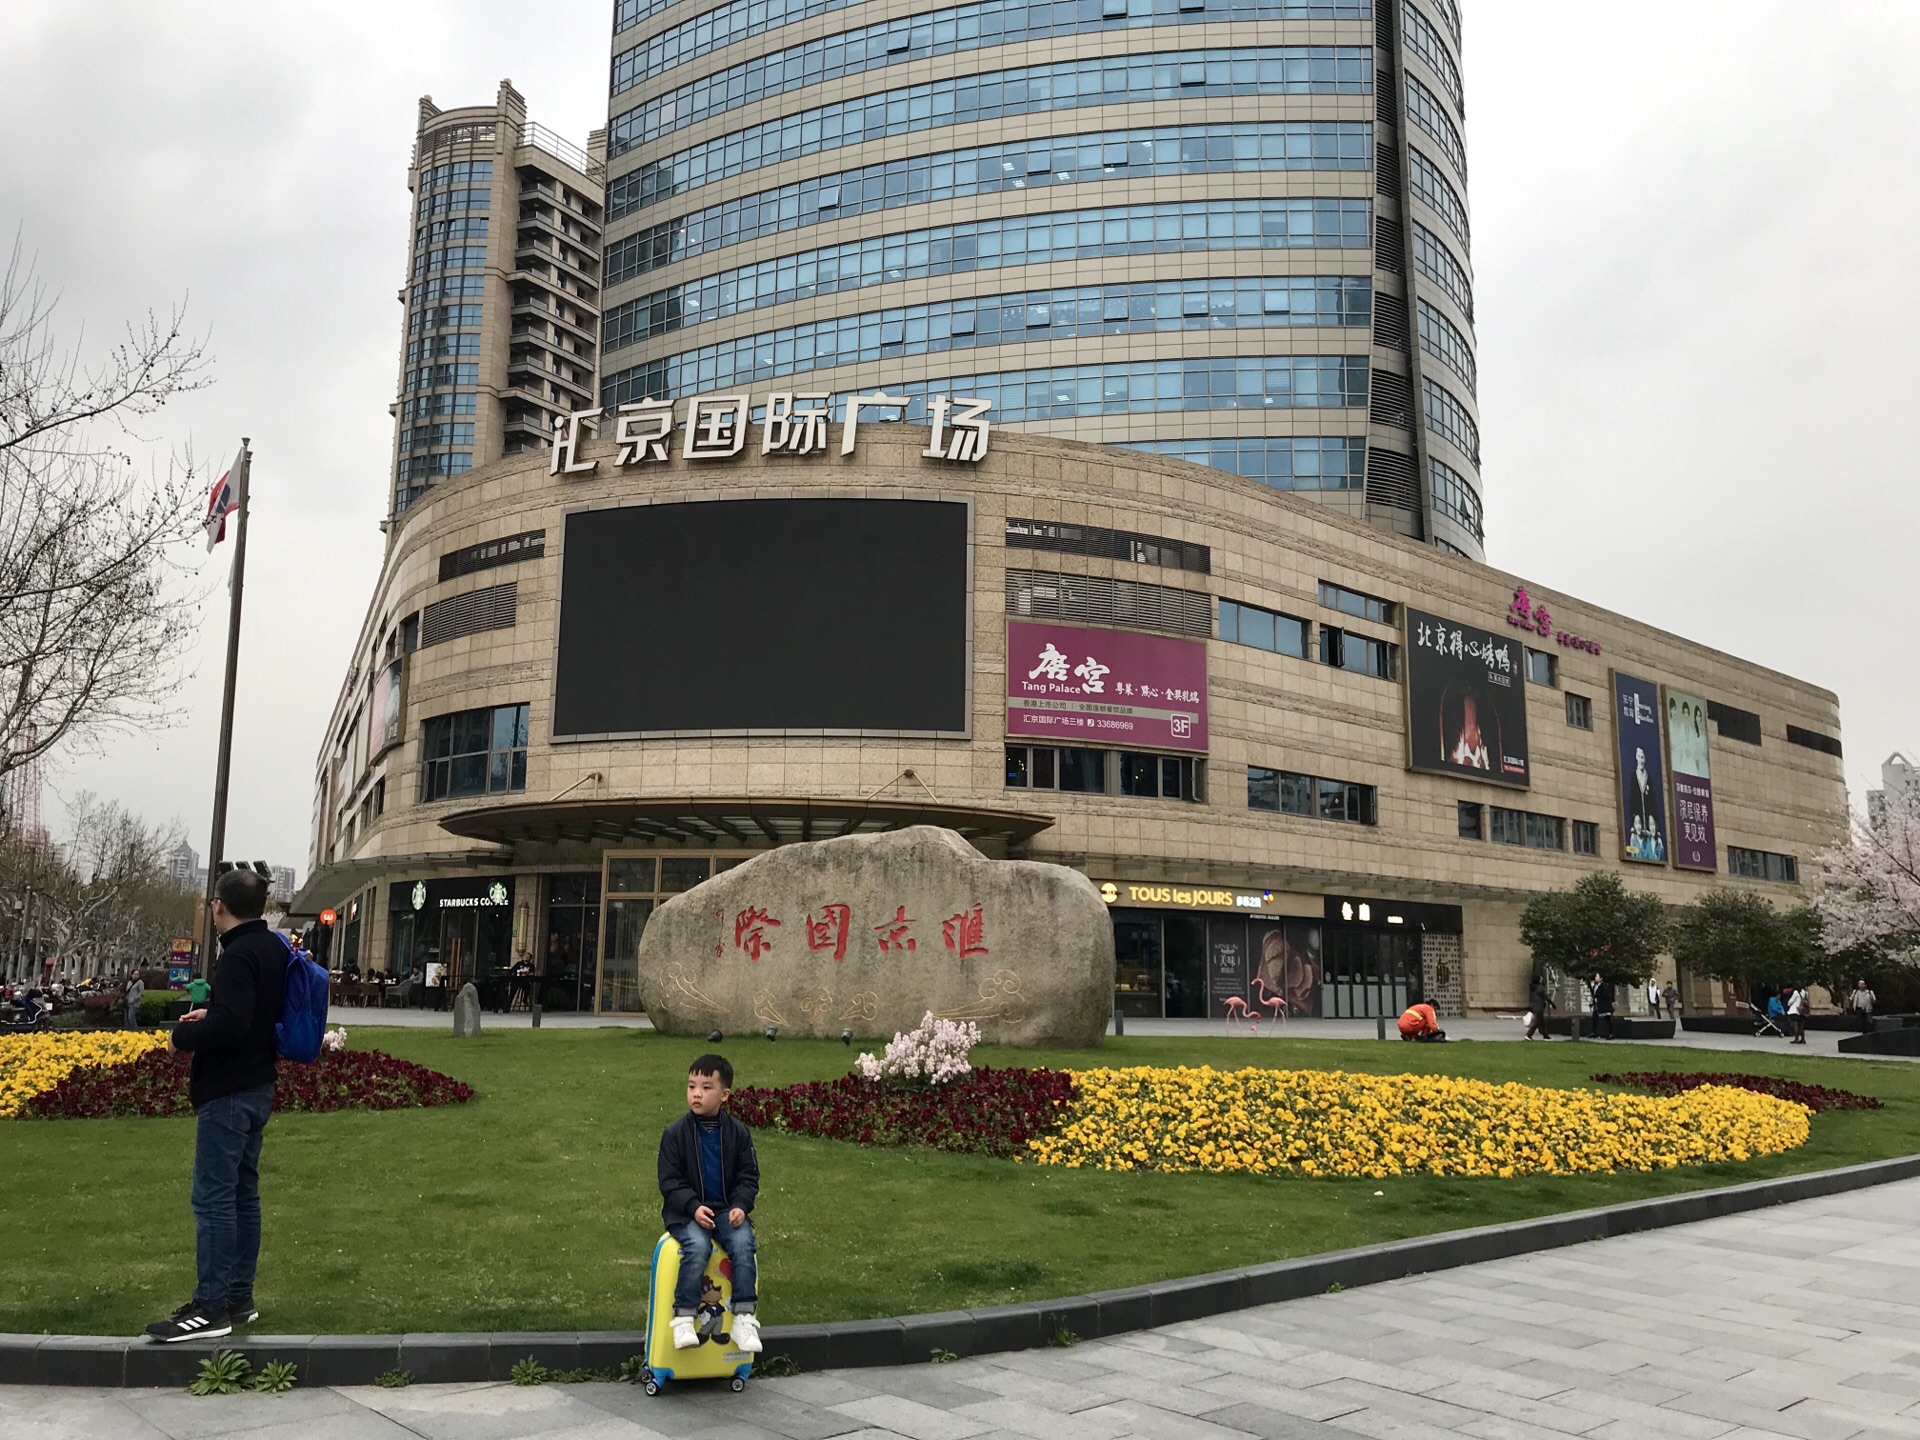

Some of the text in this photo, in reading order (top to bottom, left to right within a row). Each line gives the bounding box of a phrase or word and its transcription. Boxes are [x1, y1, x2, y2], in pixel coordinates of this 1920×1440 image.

[550, 391, 993, 476] 汇京国际广场
[1417, 621, 1511, 673] 北京得心烤鸭
[1022, 681, 1081, 695] Tang Palace
[1023, 700, 1067, 710] 香港上市公司
[1023, 714, 1134, 731] 汇京国际广场三楼 33686969
[1173, 719, 1190, 733] 3F
[1684, 822, 1708, 844] 更见效
[439, 898, 479, 908] STARBUCKS
[1129, 886, 1233, 906] TOUS les JOURS
